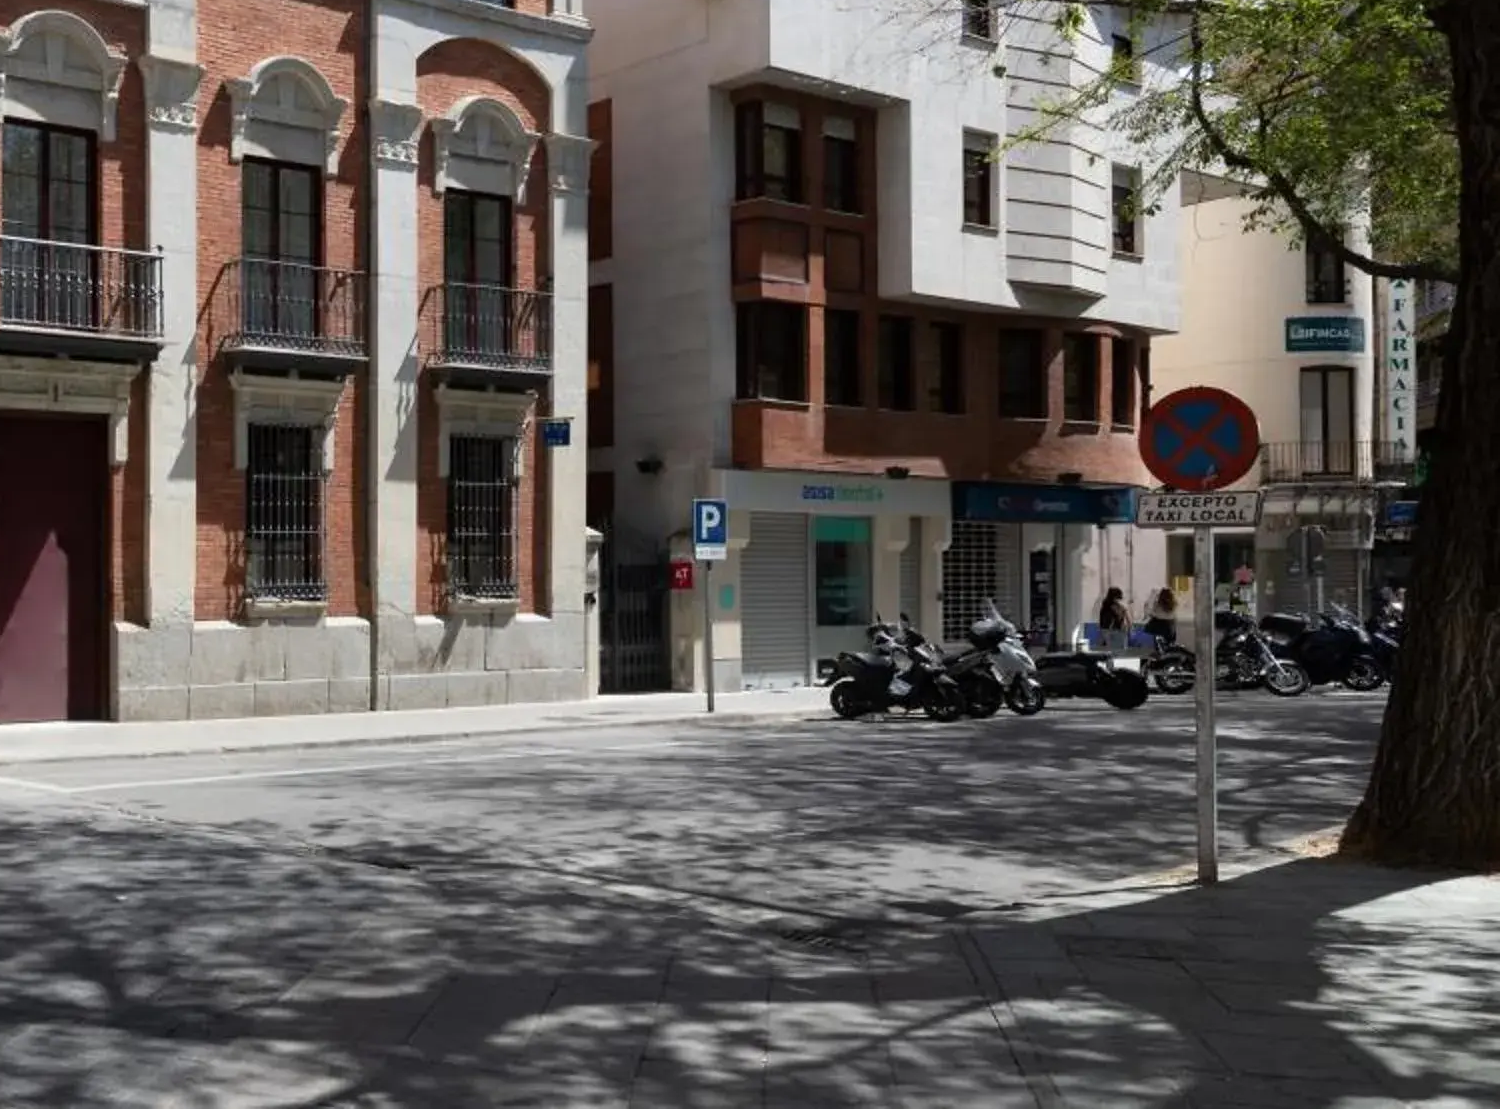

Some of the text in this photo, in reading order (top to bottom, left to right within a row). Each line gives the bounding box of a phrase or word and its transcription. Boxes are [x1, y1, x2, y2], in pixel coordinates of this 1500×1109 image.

[1389, 298, 1410, 450] FARMACIA
[1157, 495, 1237, 508] EXCEPTO
[700, 504, 721, 540] P
[1145, 509, 1246, 522] TAXI LOCAL
